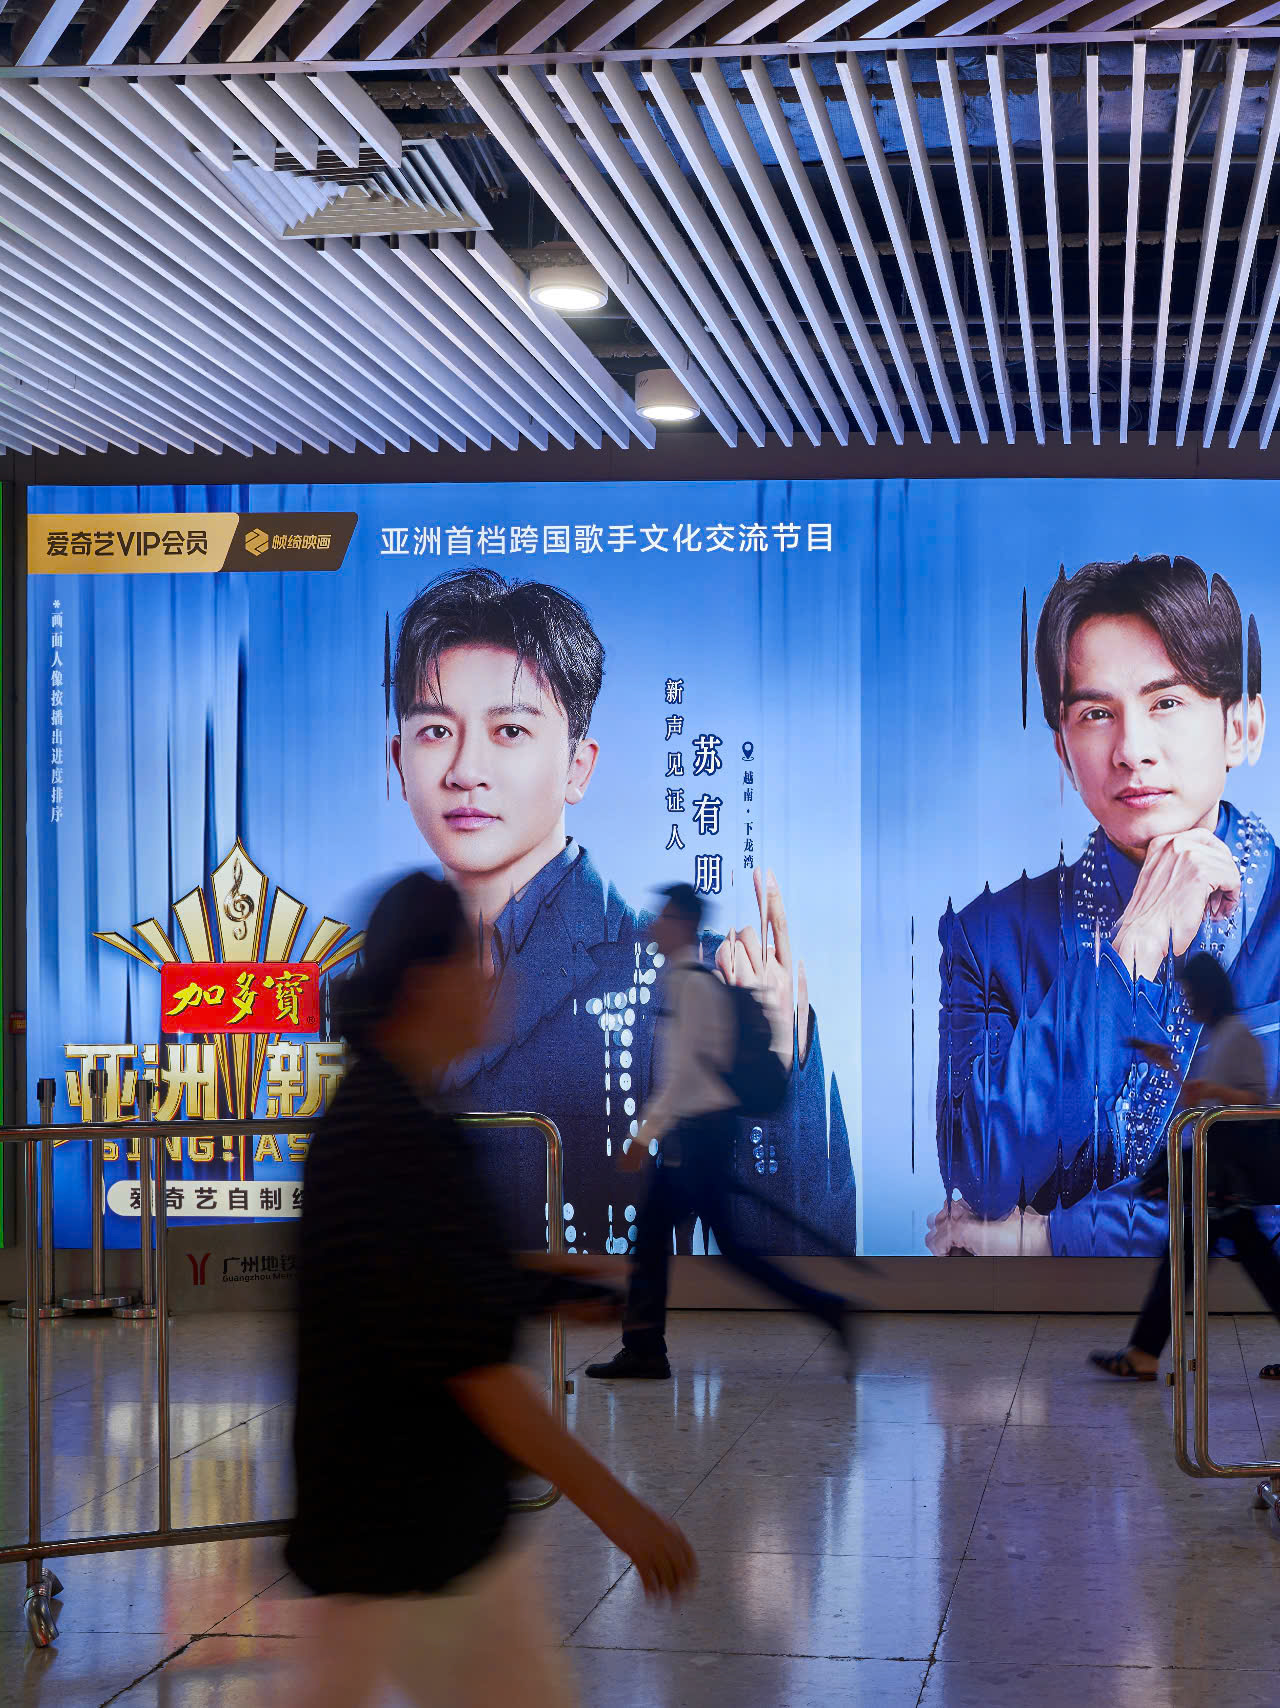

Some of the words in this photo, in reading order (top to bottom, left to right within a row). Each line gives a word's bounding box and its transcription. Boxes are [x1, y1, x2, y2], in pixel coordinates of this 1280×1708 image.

[46, 531, 209, 557] 爱奇艺VIP会员
[380, 522, 834, 556] 亚洲首档跨国歌手文化交流节目
[665, 678, 685, 850] 新声见证人
[692, 734, 723, 895] 苏有朋
[165, 970, 311, 1026] 加多寶
[63, 1040, 348, 1122] 亚洲新
[222, 1254, 297, 1275] 广州地铁
